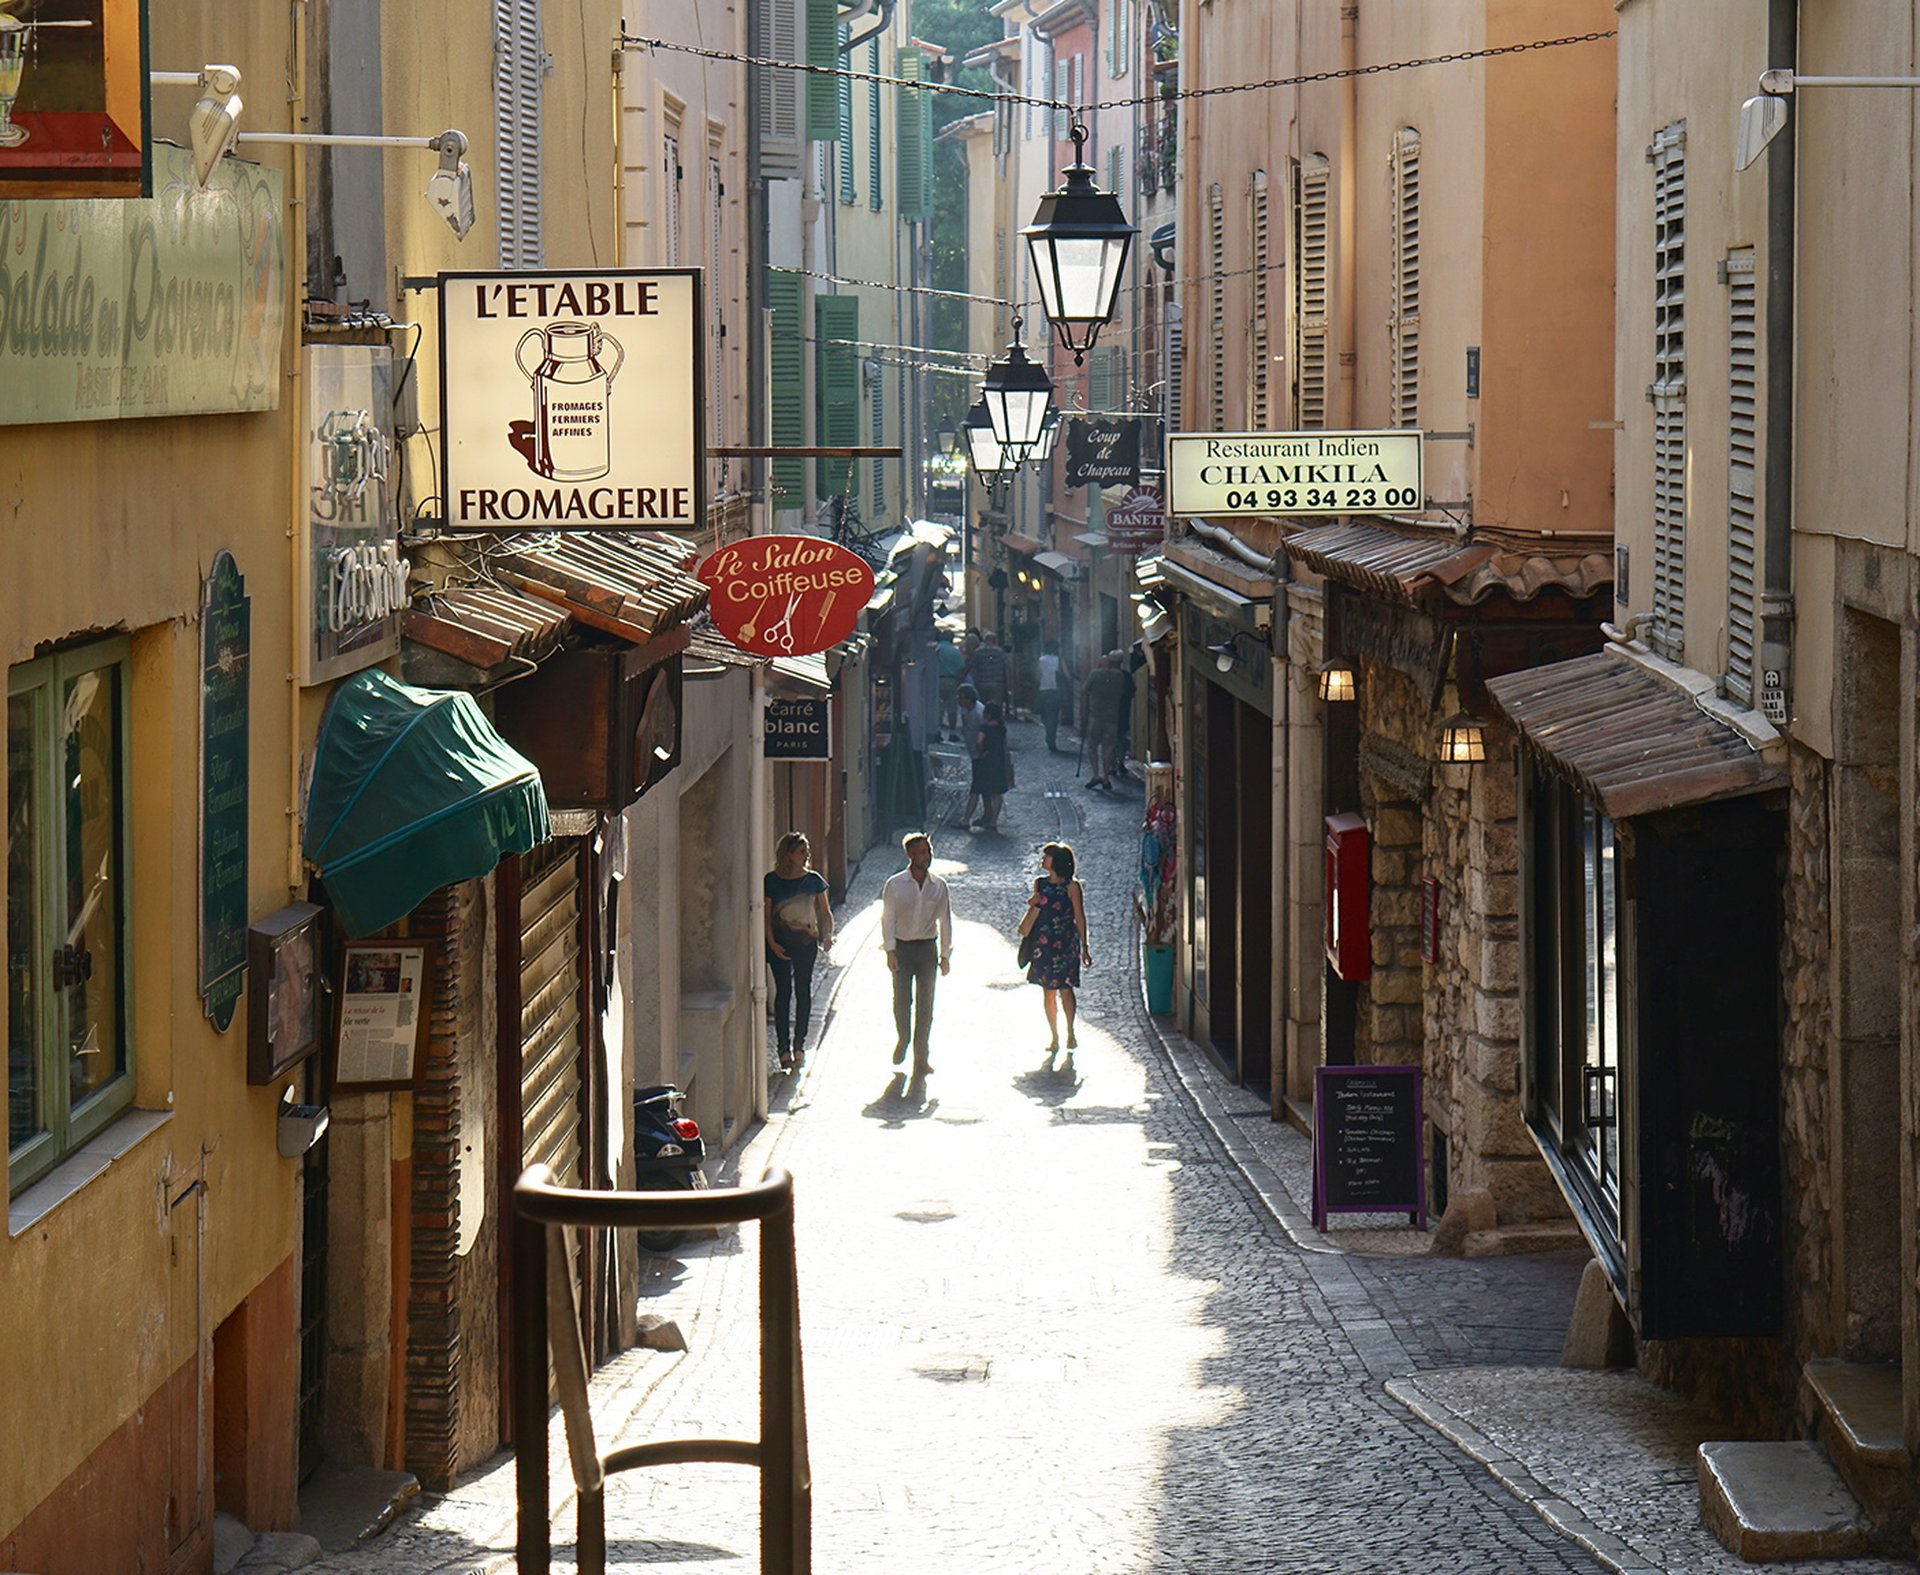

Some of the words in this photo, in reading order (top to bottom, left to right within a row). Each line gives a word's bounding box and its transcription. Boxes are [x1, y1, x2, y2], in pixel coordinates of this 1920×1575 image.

[476, 282, 659, 318] L'ETABLE
[552, 402, 603, 411] FROMAGES
[552, 415, 600, 424] FERMIERS
[552, 428, 592, 437] AFFINES
[1087, 429, 1121, 445] Coup
[1096, 447, 1113, 460] de
[1206, 440, 1310, 458] Restaurant
[1318, 438, 1380, 458] Indien
[1077, 463, 1132, 479] Chapeau
[1200, 463, 1391, 485] CHAMKILA
[460, 488, 689, 520] FROMAGERIE
[1226, 490, 1258, 509] 04
[1266, 490, 1298, 508] 93
[1306, 489, 1338, 507] 34
[1346, 489, 1377, 507] 23
[1384, 488, 1417, 506] 00
[705, 550, 746, 584] Le
[752, 540, 838, 572] Salon
[727, 568, 862, 602] Coiffeuse
[765, 719, 820, 734] blanc
